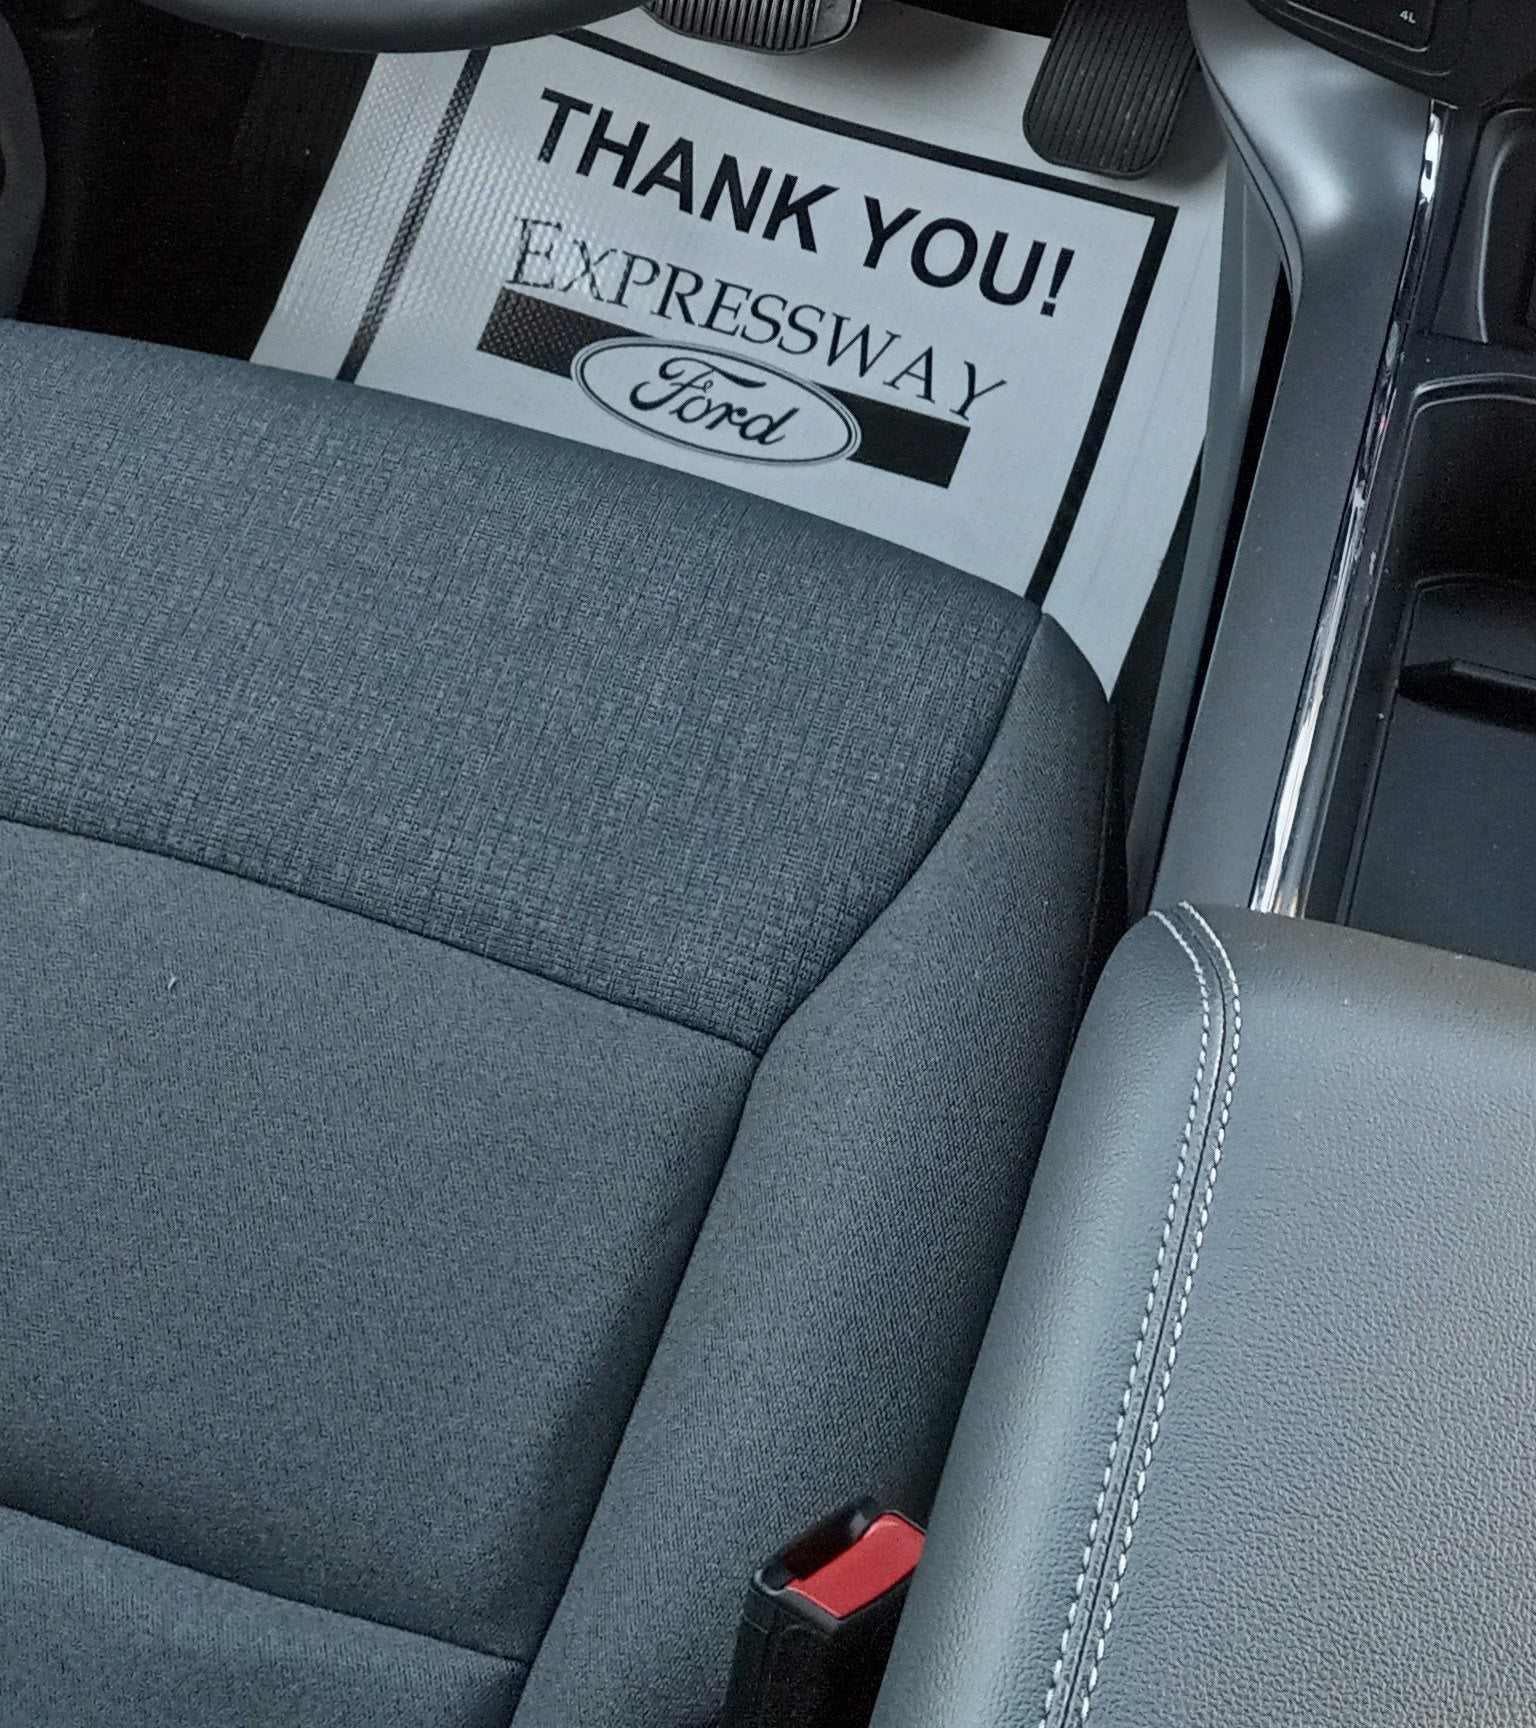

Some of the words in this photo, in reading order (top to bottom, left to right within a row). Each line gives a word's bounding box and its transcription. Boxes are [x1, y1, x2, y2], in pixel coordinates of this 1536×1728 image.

[1398, 8, 1417, 25] 4L
[537, 87, 841, 254] THANK
[862, 194, 1076, 318] YOU!
[505, 213, 1009, 422] EXPRESSWAY
[628, 353, 801, 448] Ford
